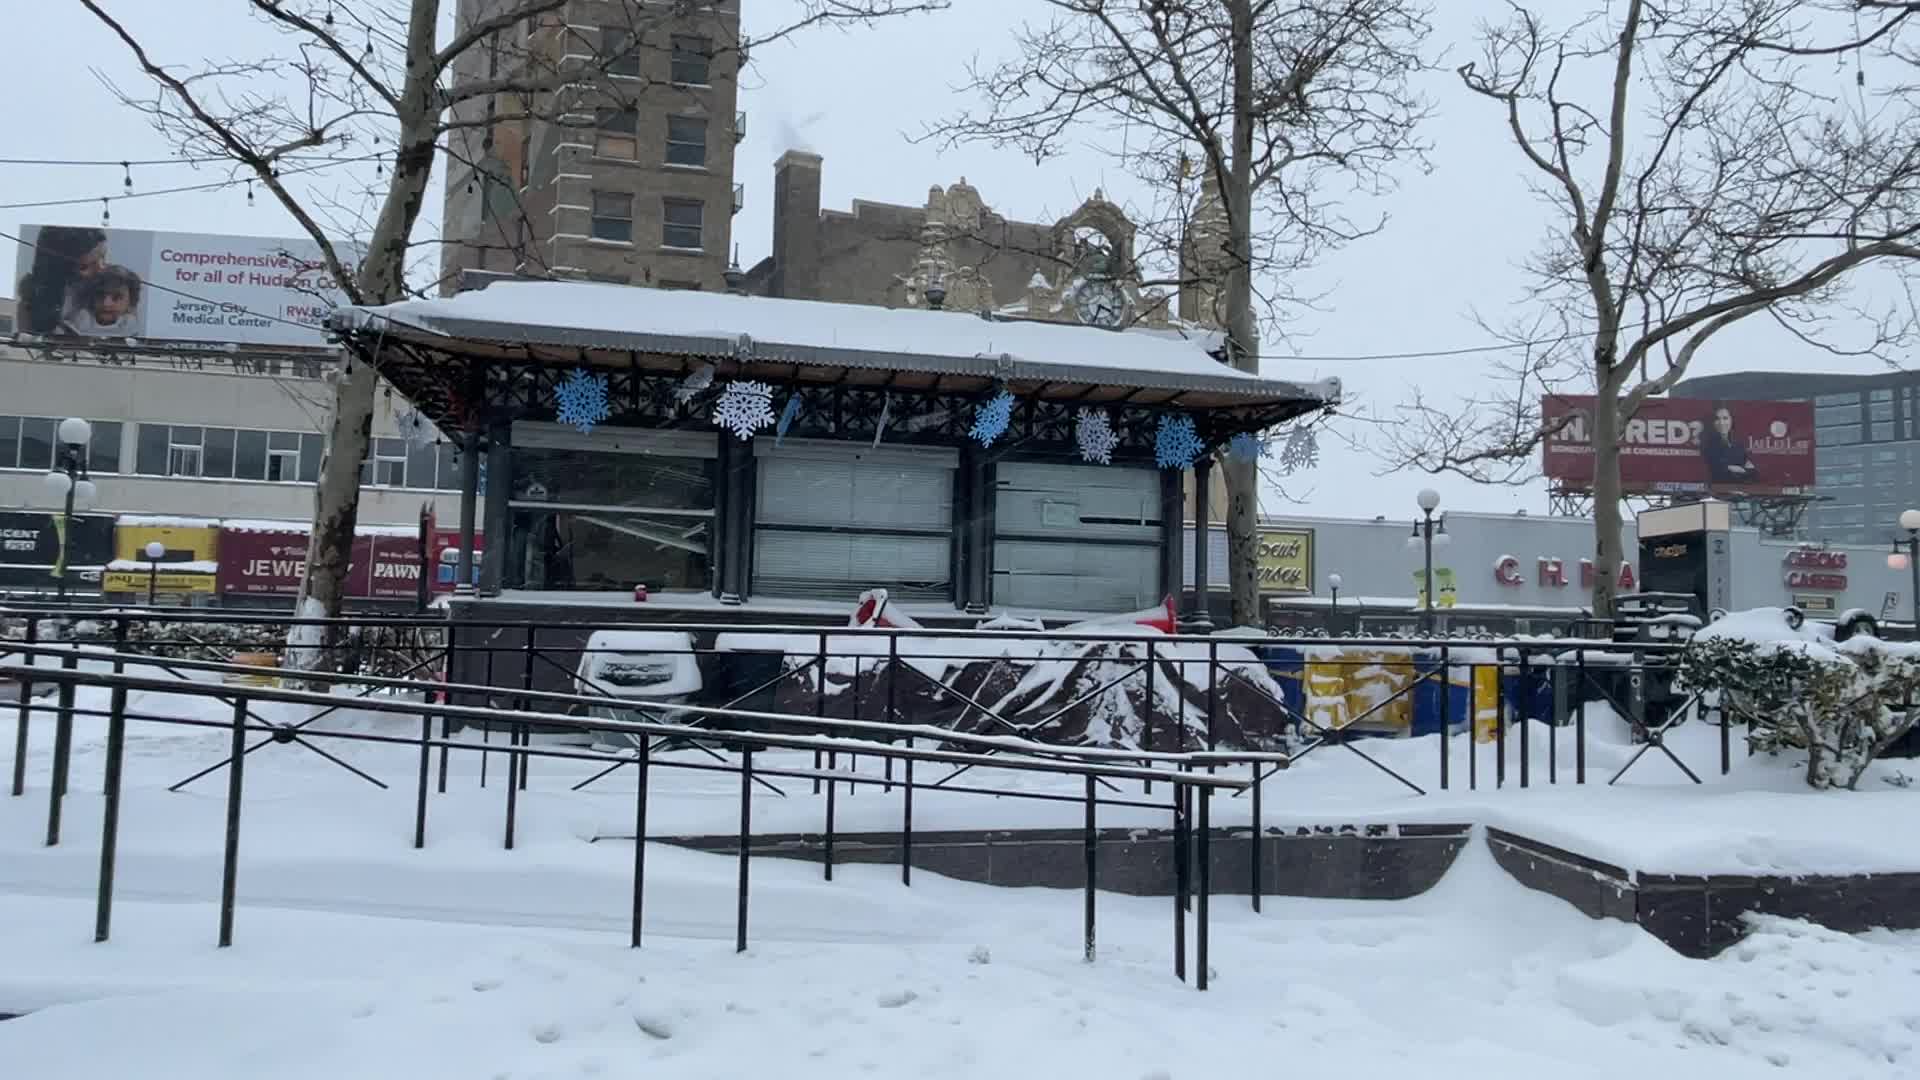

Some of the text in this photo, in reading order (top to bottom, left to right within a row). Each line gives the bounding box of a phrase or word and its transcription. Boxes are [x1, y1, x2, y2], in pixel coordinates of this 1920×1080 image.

[160, 249, 289, 269] Comprehensive
[175, 268, 200, 281] for
[203, 270, 222, 284] all
[227, 272, 245, 285] of
[173, 300, 216, 315] Jersey
[173, 312, 273, 328] Medical Center
[1551, 416, 1704, 445] INRED?
[373, 563, 421, 579] PAWN
[1256, 566, 1302, 584] ersey
